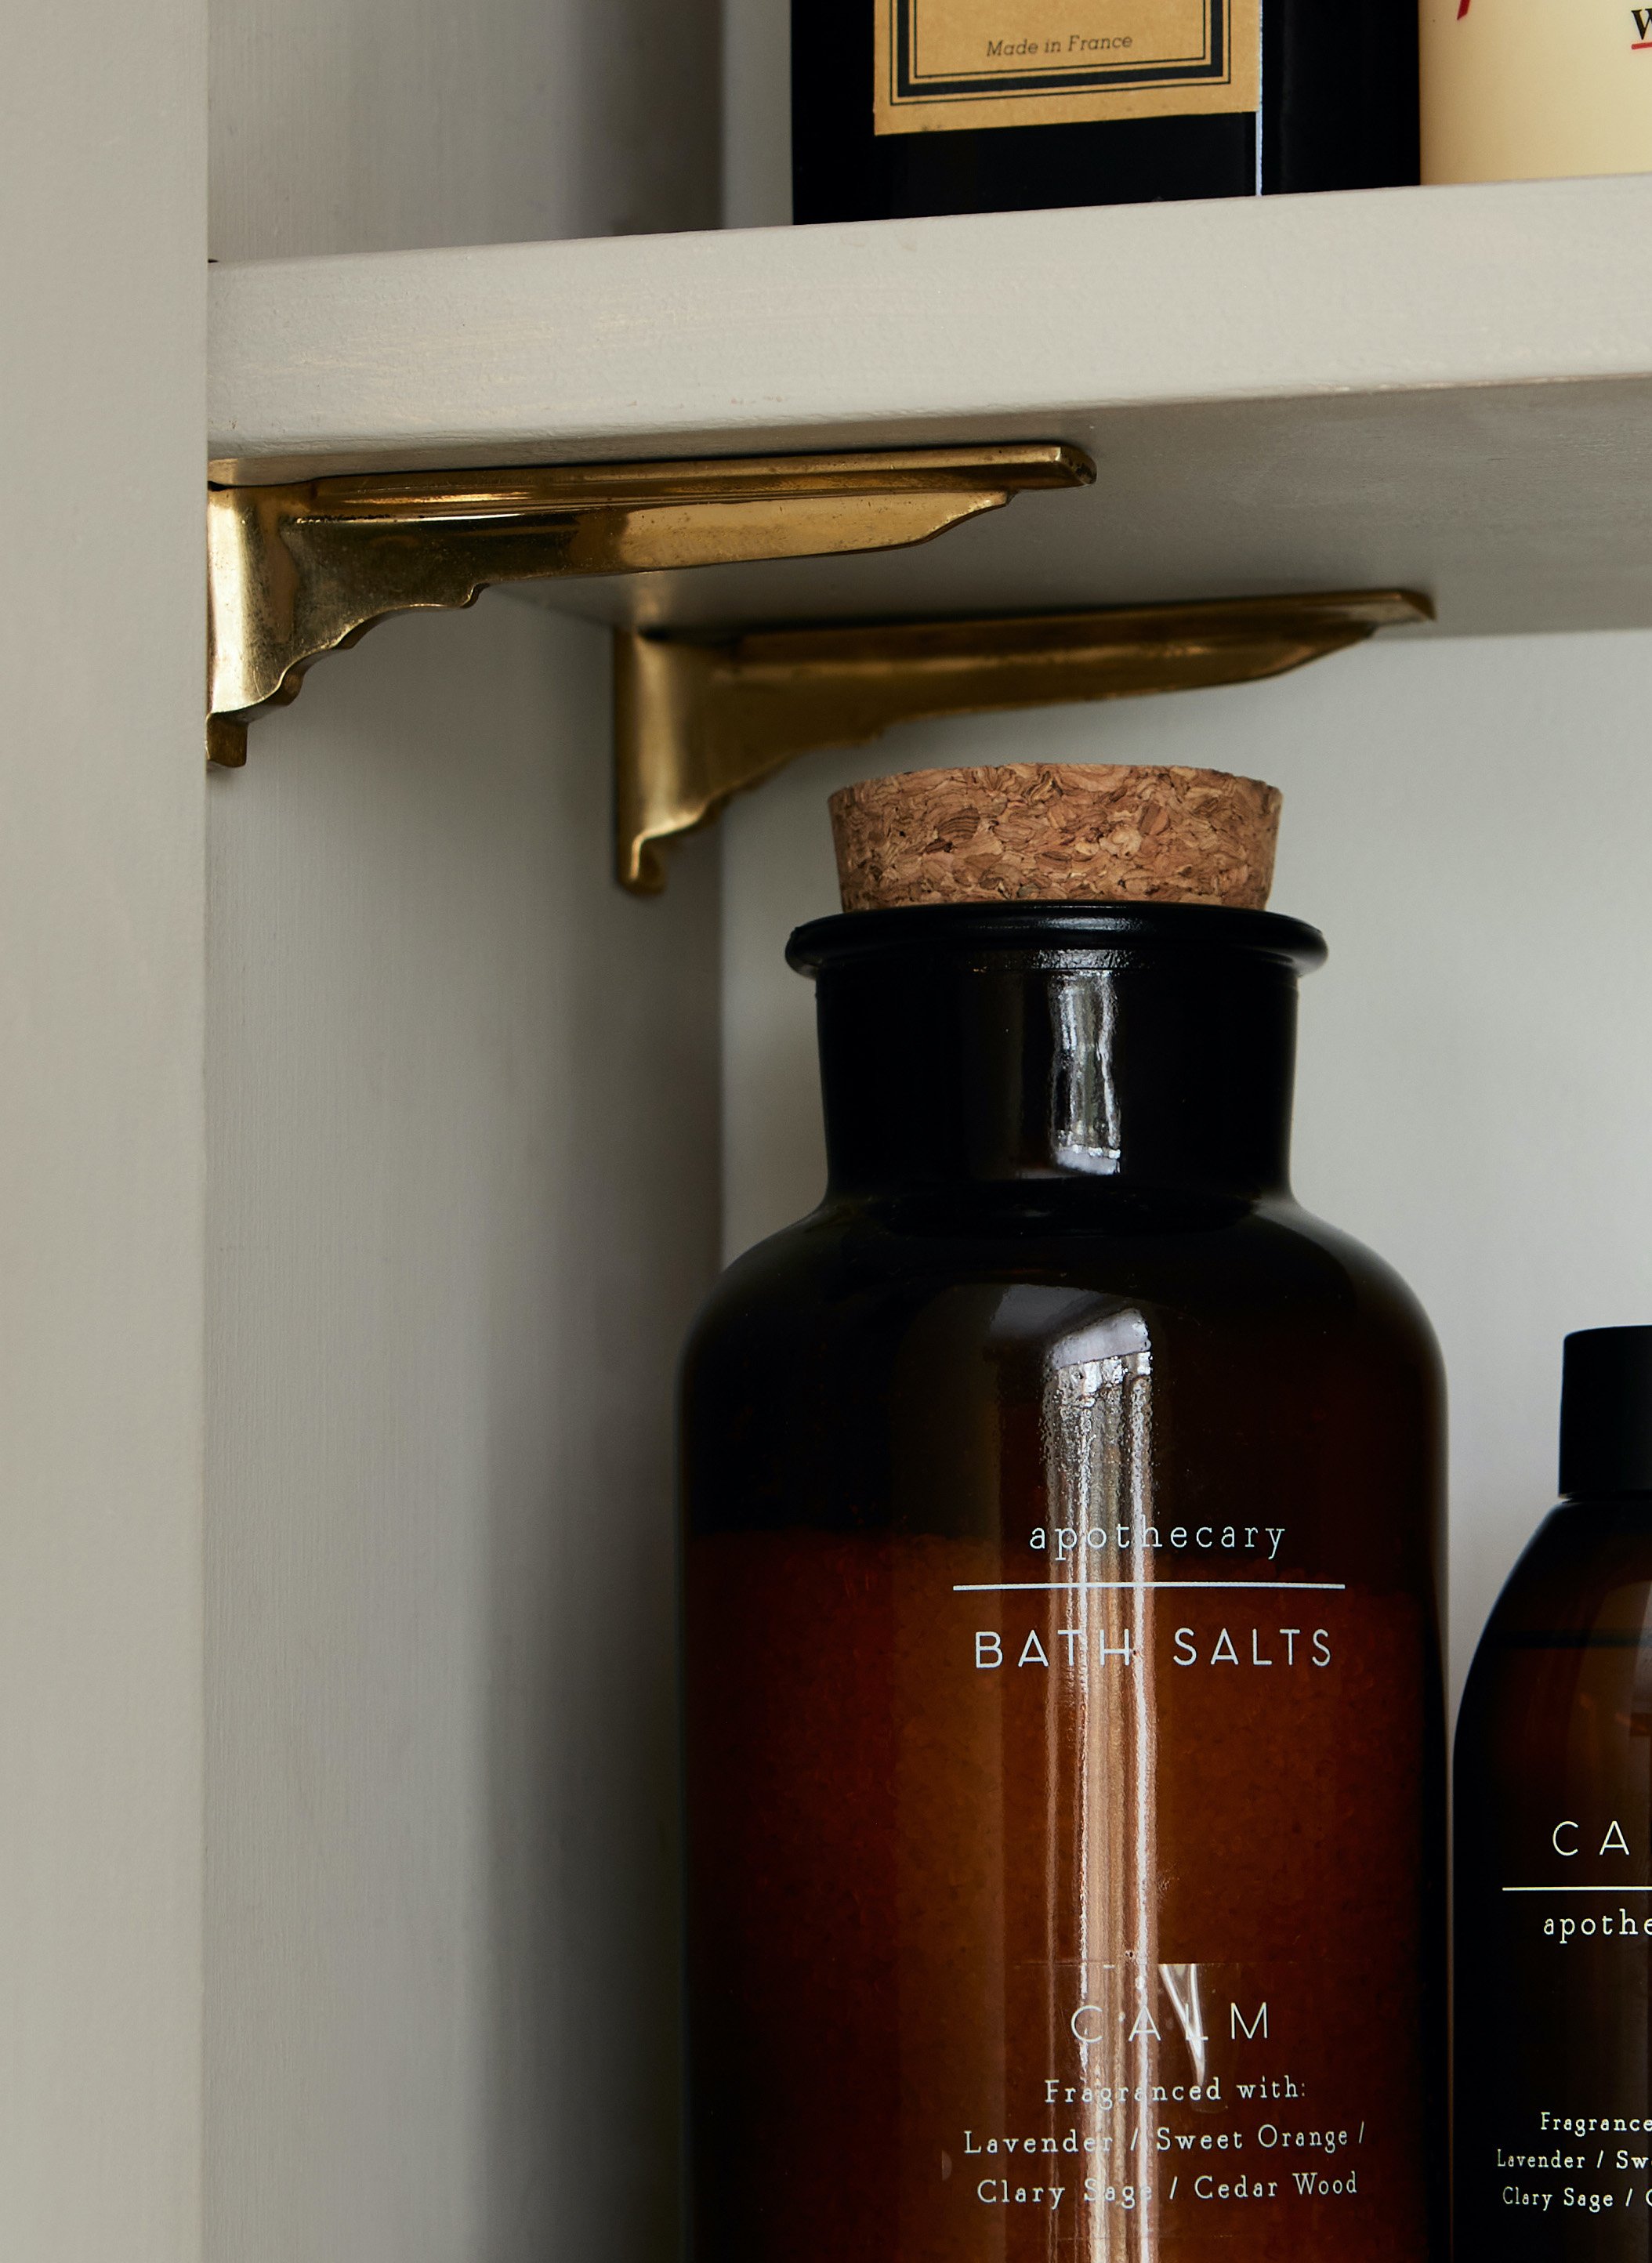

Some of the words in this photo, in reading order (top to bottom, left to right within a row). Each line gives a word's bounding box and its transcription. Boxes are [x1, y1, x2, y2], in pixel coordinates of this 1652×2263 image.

[986, 39, 1038, 57] Made
[1044, 39, 1062, 53] in
[1067, 34, 1133, 53] France
[1029, 1514, 1285, 1560] apothecary
[975, 1629, 1130, 1668] BATH
[1172, 1628, 1331, 1667] SALTS
[1071, 2001, 1269, 2043] CALM
[1044, 2077, 1222, 2110] Fragranced
[1236, 2075, 1307, 2098] with:
[964, 2128, 1114, 2154] Lavender
[1156, 2127, 1243, 2151] Sweet
[1258, 2123, 1349, 2153] Orange
[1497, 2149, 1585, 2168] Lavender
[1616, 2149, 1652, 2170] Sw
[976, 2178, 1066, 2209] Clary
[1083, 2179, 1153, 2209] Sage
[1194, 2174, 1279, 2199] Cedar
[1292, 2171, 1358, 2197] Wood
[1502, 2186, 1553, 2211] Clary
[1563, 2187, 1614, 2213] Sage
